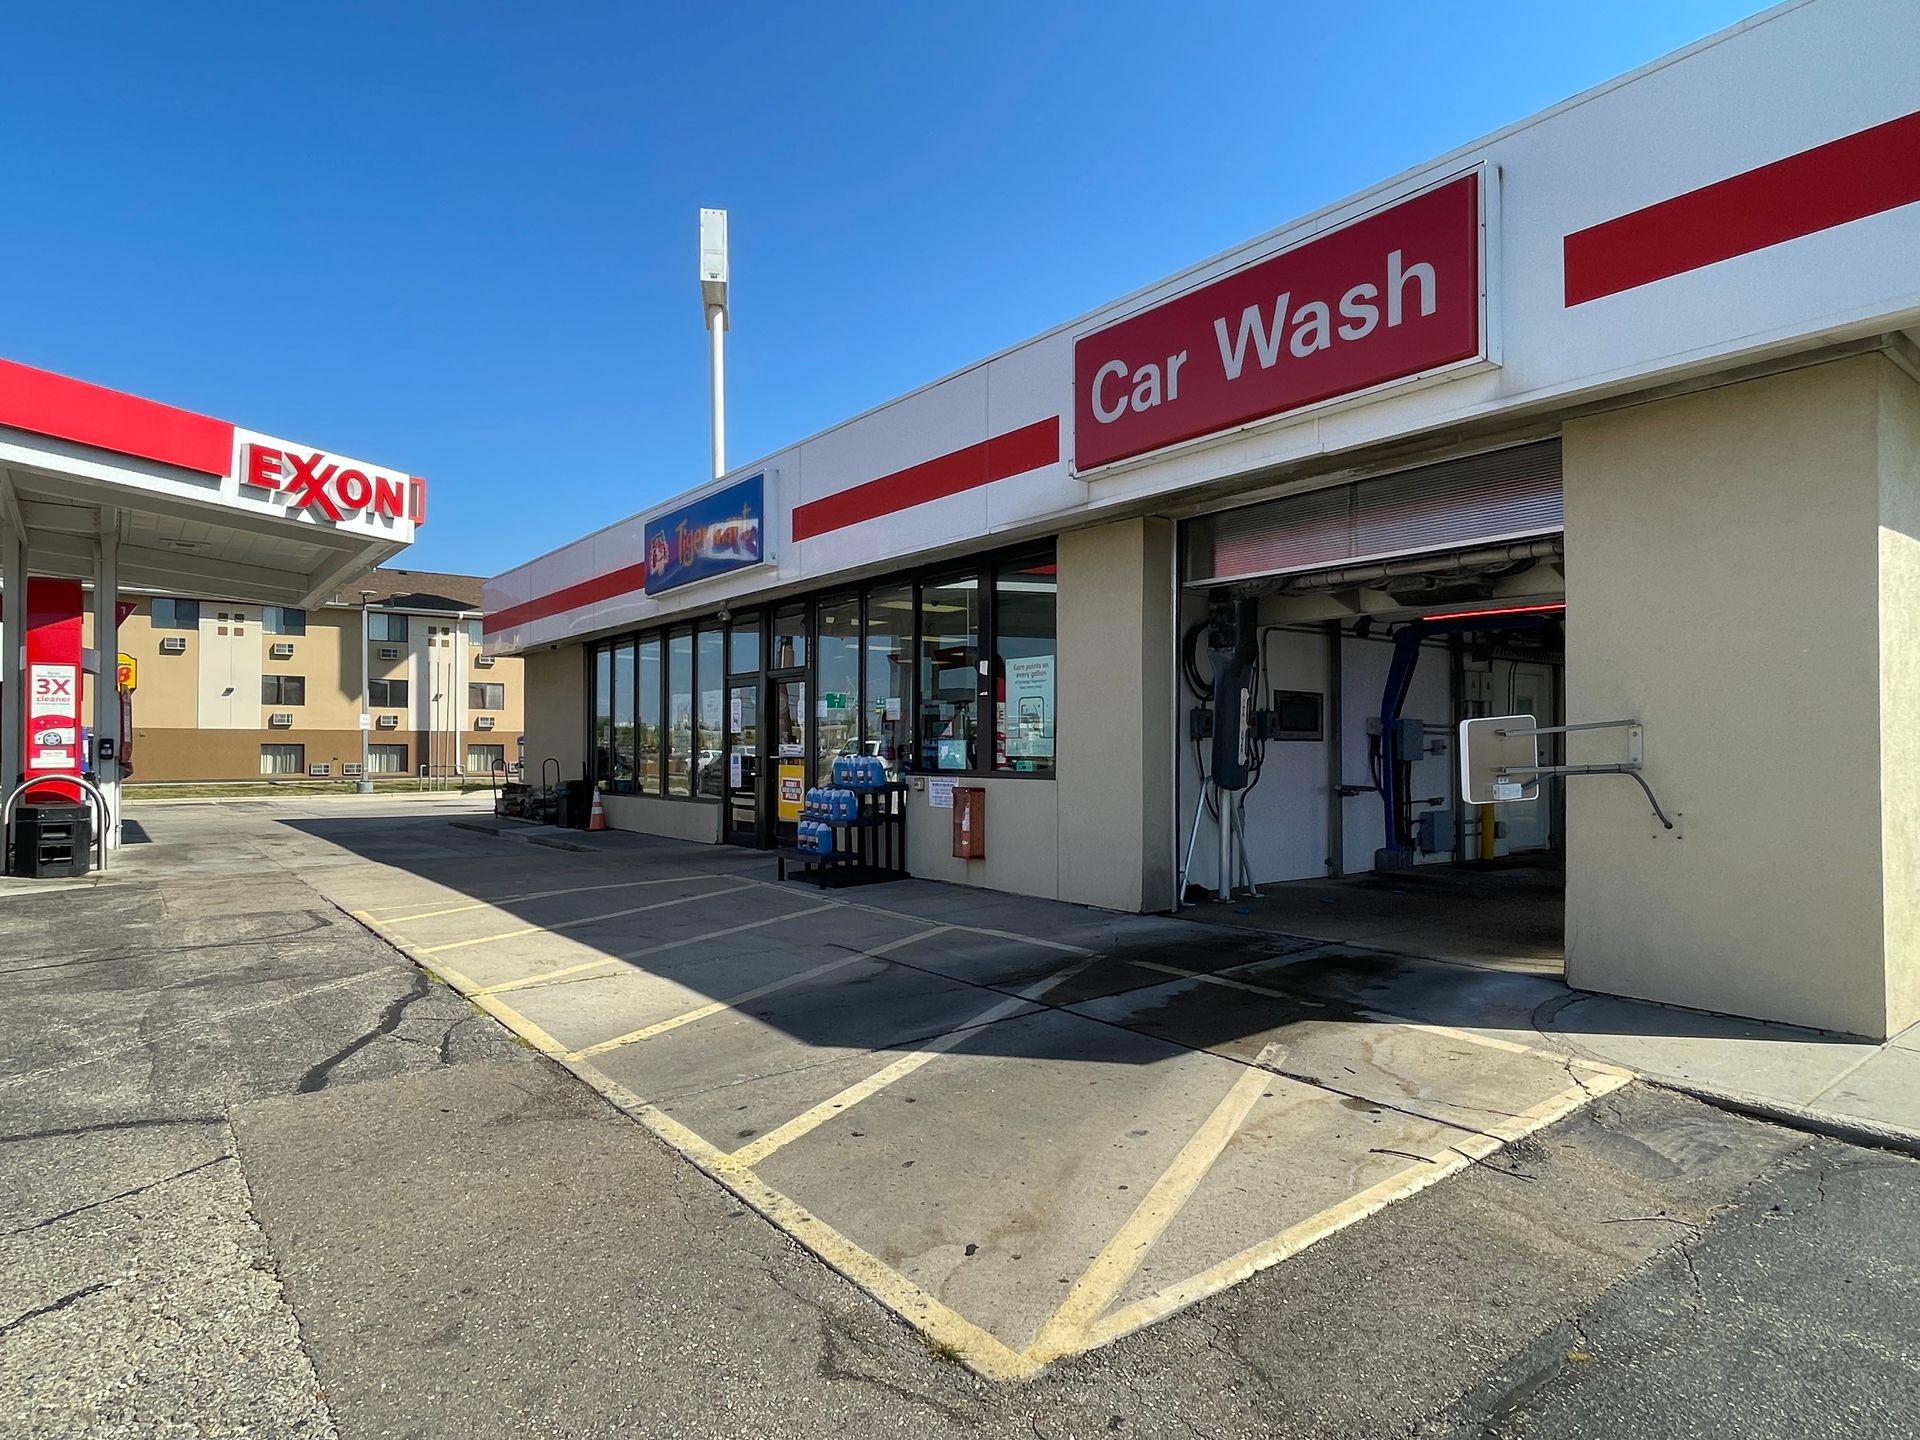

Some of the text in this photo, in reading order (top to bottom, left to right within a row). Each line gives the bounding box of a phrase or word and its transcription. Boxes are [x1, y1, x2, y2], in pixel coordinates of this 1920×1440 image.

[1091, 249, 1437, 425] Car Wash
[245, 443, 404, 521] EXXON
[36, 678, 71, 695] 3X
